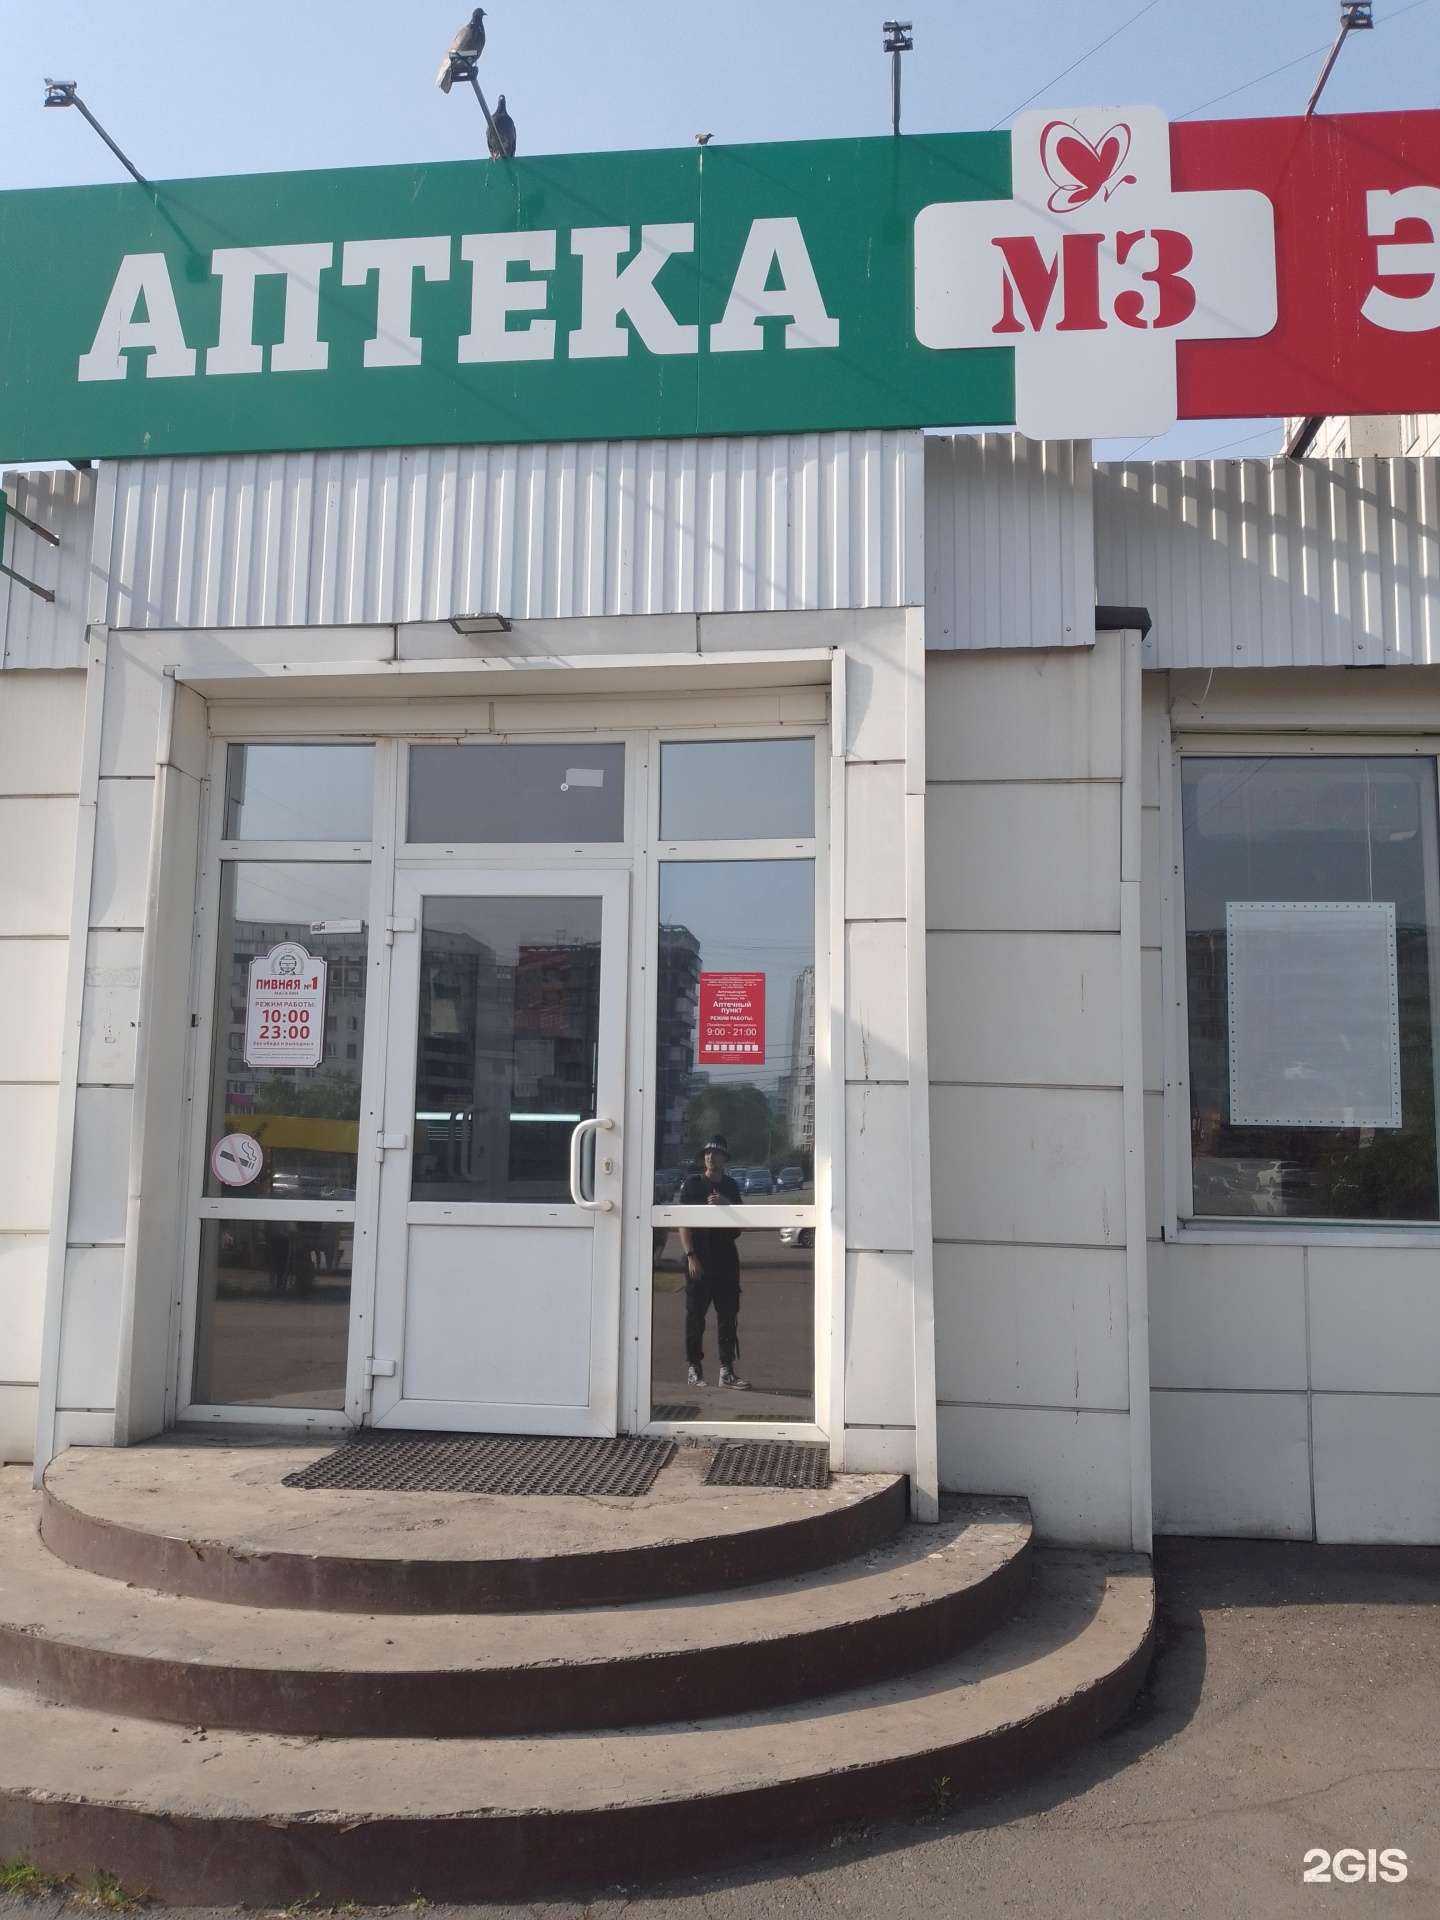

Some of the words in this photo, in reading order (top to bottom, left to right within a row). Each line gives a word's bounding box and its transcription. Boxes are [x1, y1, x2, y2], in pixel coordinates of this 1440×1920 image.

[991, 228, 1196, 334] МЗ
[77, 217, 840, 382] АПТЕКА
[256, 979, 301, 990] ПИВНАЯ
[712, 1000, 752, 1008] Аптечный
[262, 1009, 310, 1023] 10:00
[259, 1025, 310, 1039] 23:00
[707, 1028, 726, 1036] 9:00
[733, 1028, 757, 1036] 21:00
